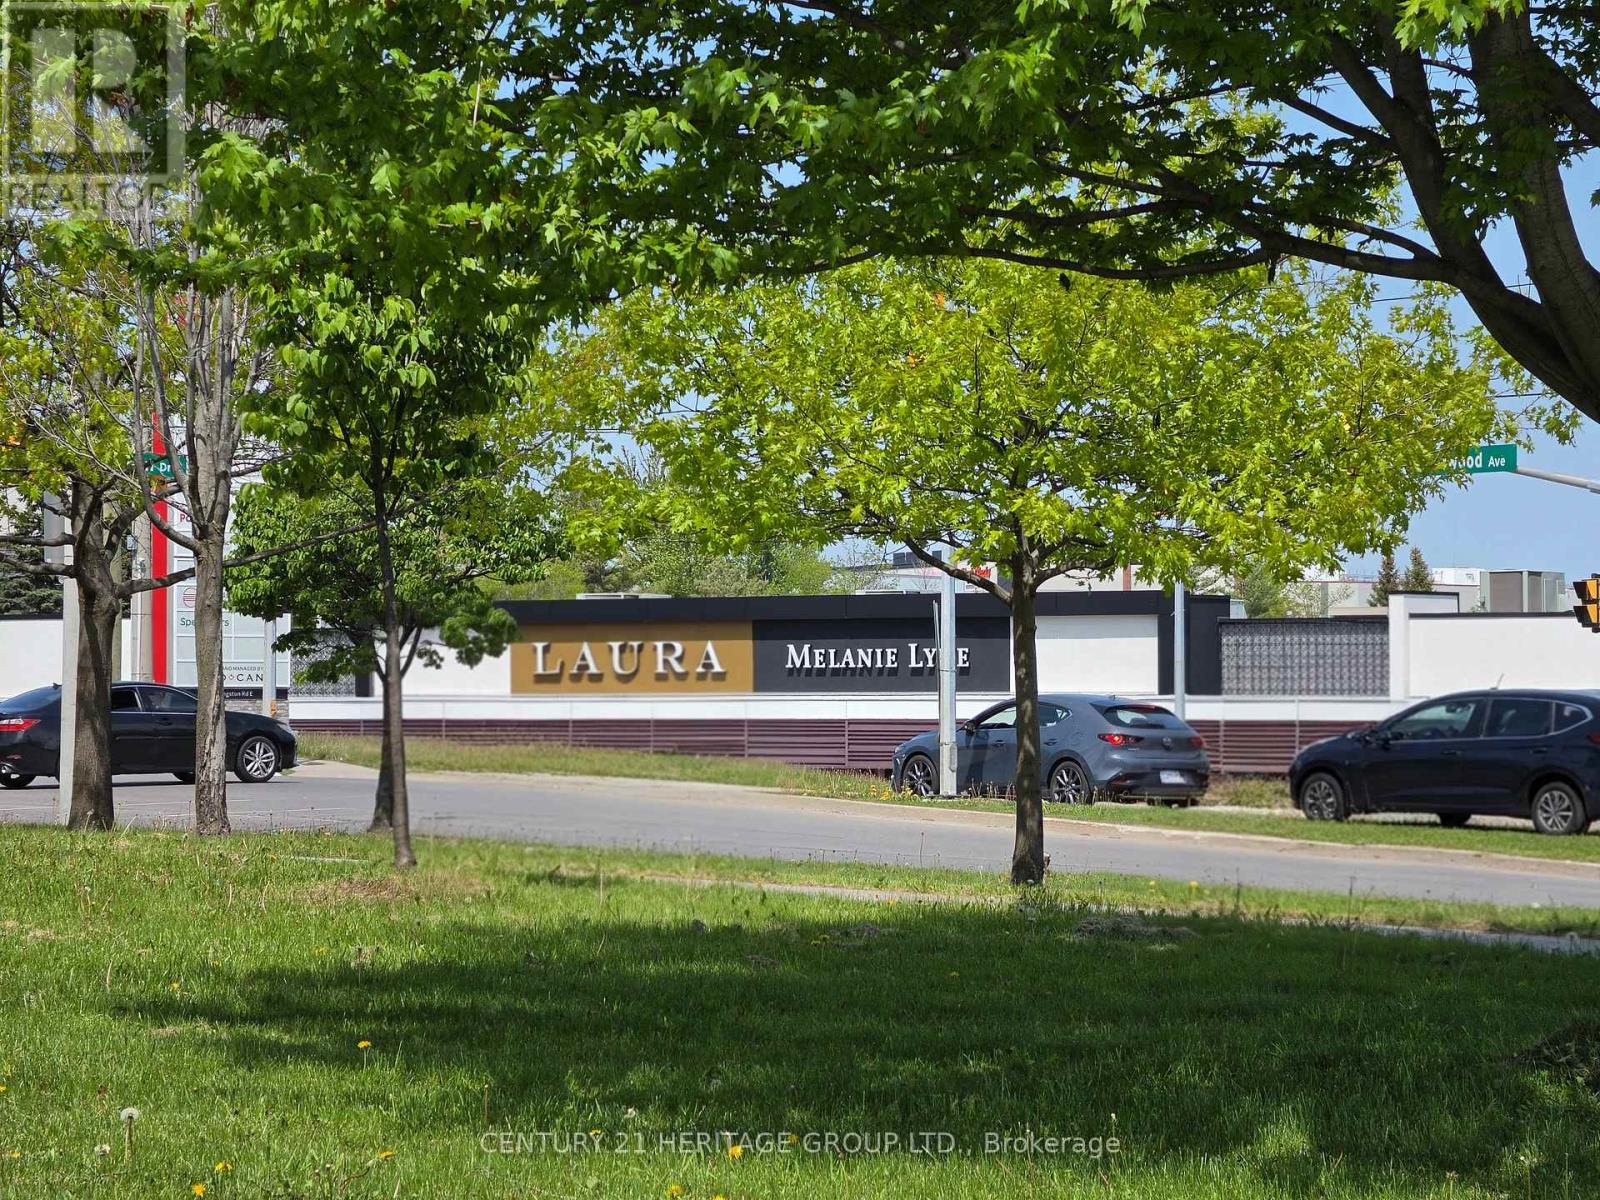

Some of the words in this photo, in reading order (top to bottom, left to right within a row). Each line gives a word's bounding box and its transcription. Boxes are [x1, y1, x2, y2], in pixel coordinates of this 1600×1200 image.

[1488, 456, 1506, 467] Ave
[533, 640, 727, 675] LAURA
[785, 643, 898, 669] MELANIE
[908, 643, 970, 668] LYE
